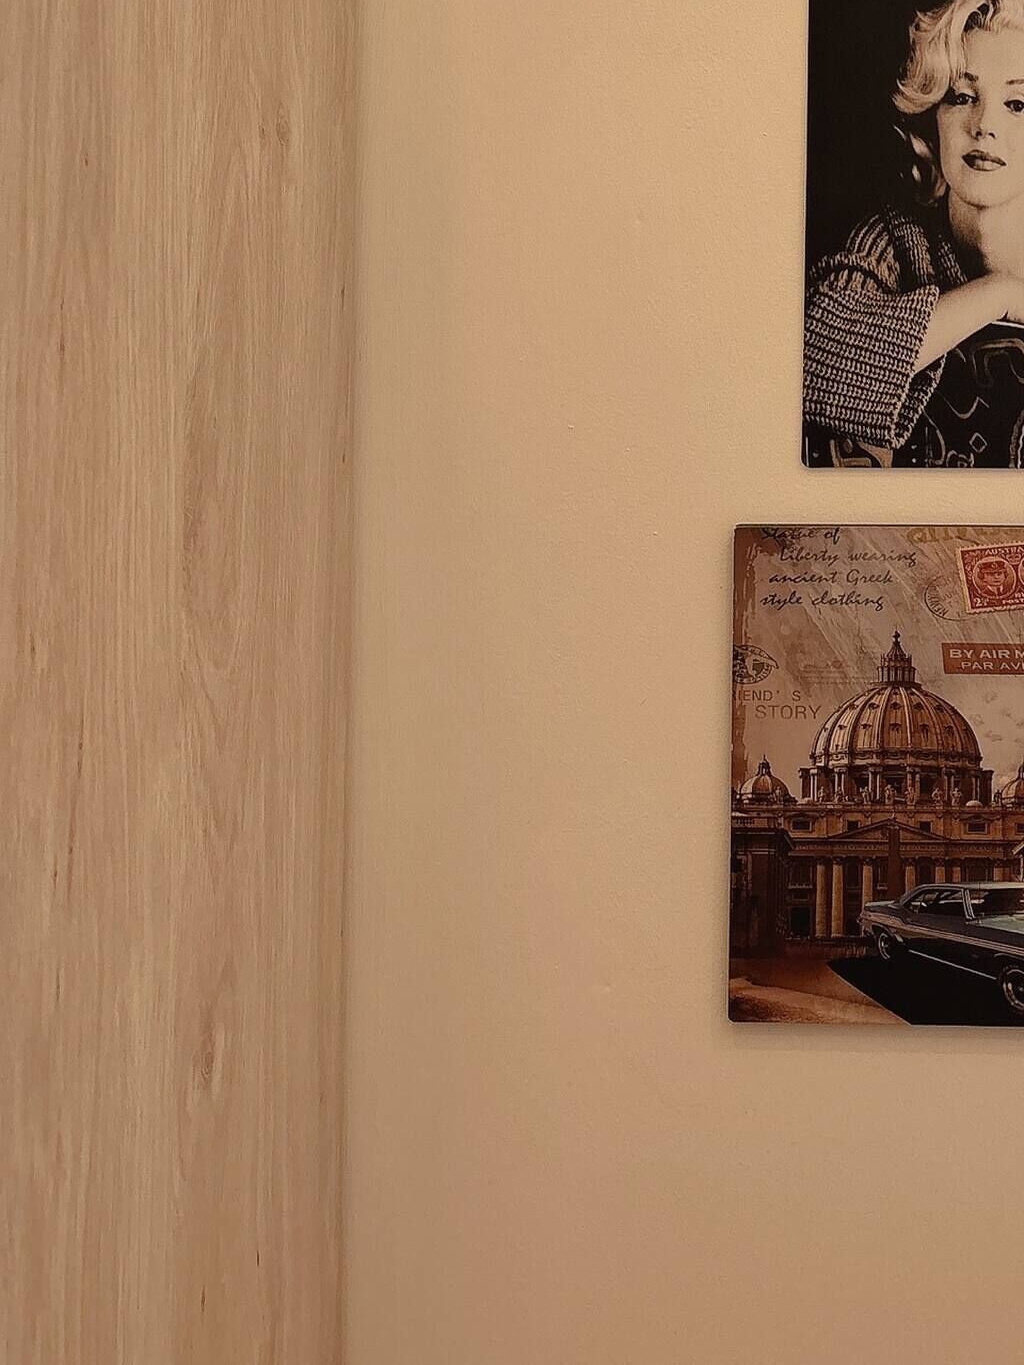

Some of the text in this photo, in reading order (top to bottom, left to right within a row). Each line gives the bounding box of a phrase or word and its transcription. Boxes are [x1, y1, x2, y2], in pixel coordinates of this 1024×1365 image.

[822, 527, 840, 545] of
[780, 546, 917, 568] Liberty wearing
[769, 569, 893, 585] ancient Greek
[760, 590, 884, 611] style clothing
[949, 649, 974, 659] BY
[980, 649, 1010, 659] AIR
[960, 661, 994, 670] PAR
[755, 705, 821, 720] STORY
